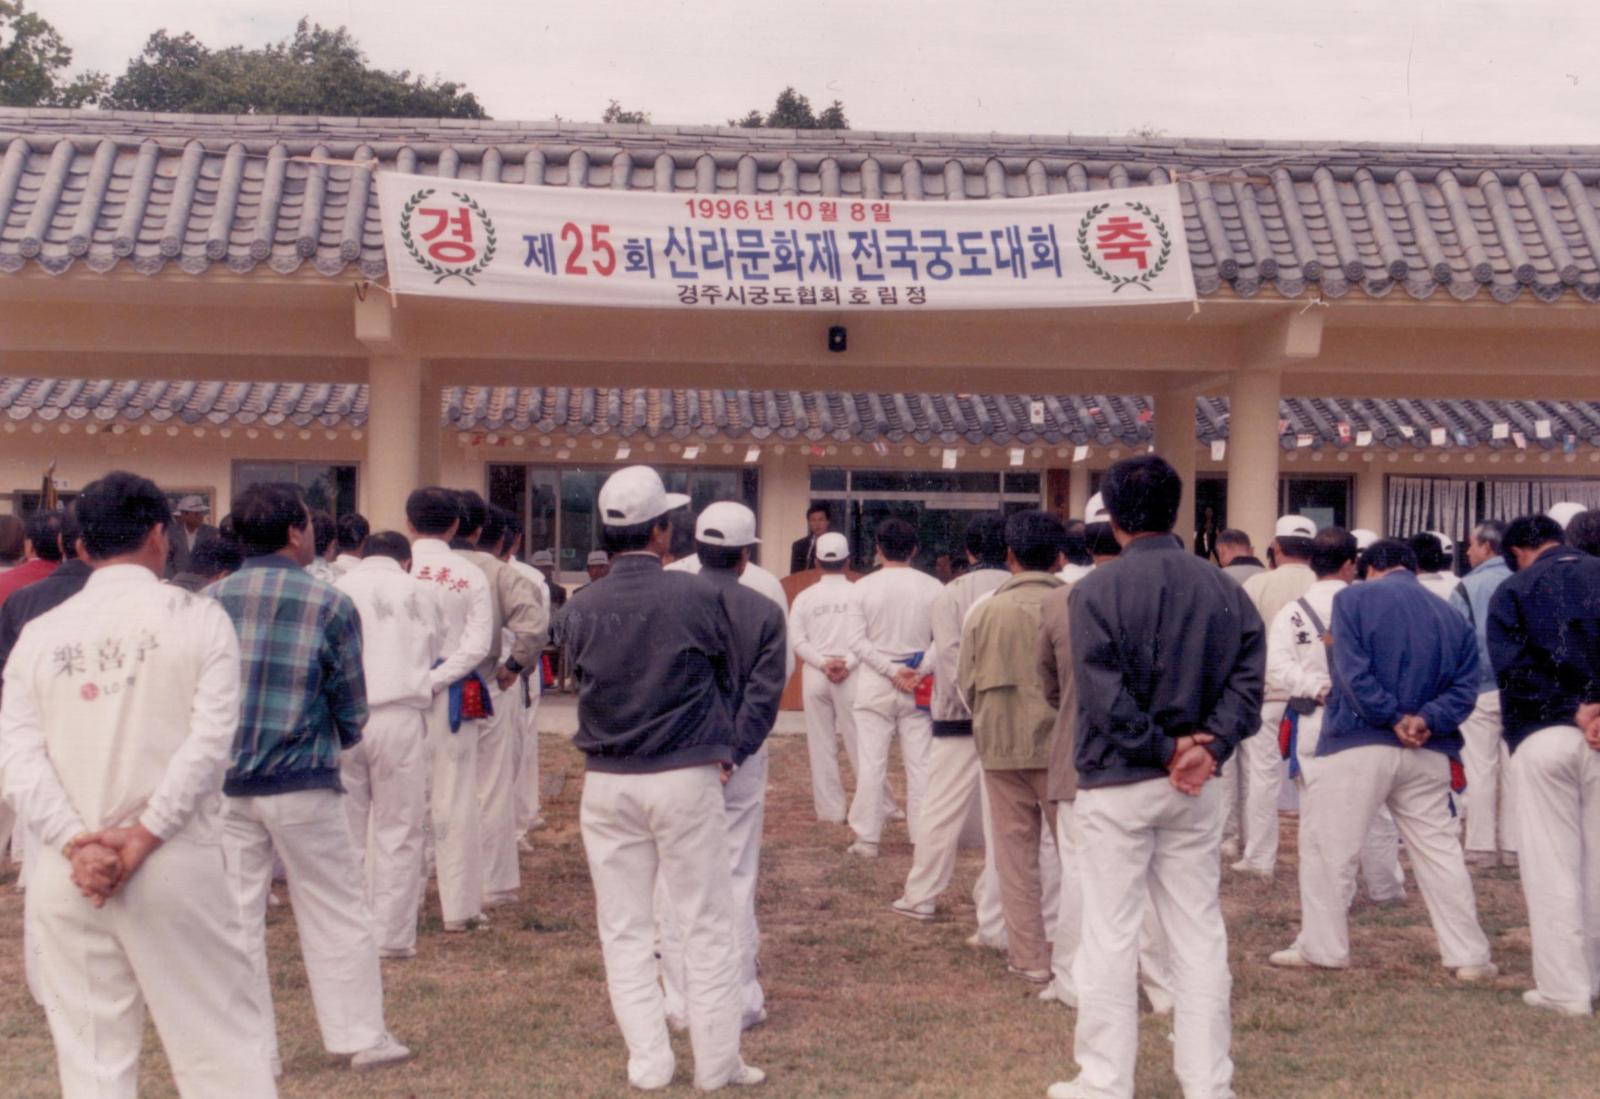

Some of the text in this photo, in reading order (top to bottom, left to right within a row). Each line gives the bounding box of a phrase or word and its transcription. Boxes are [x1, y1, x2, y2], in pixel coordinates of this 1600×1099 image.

[417, 207, 477, 264] 경
[685, 198, 892, 223] 1996년 10월 8일
[522, 222, 1063, 282] 제25회 신라문화제 전국궁도대회
[1096, 216, 1153, 270] 축
[848, 285, 928, 305] 호림정
